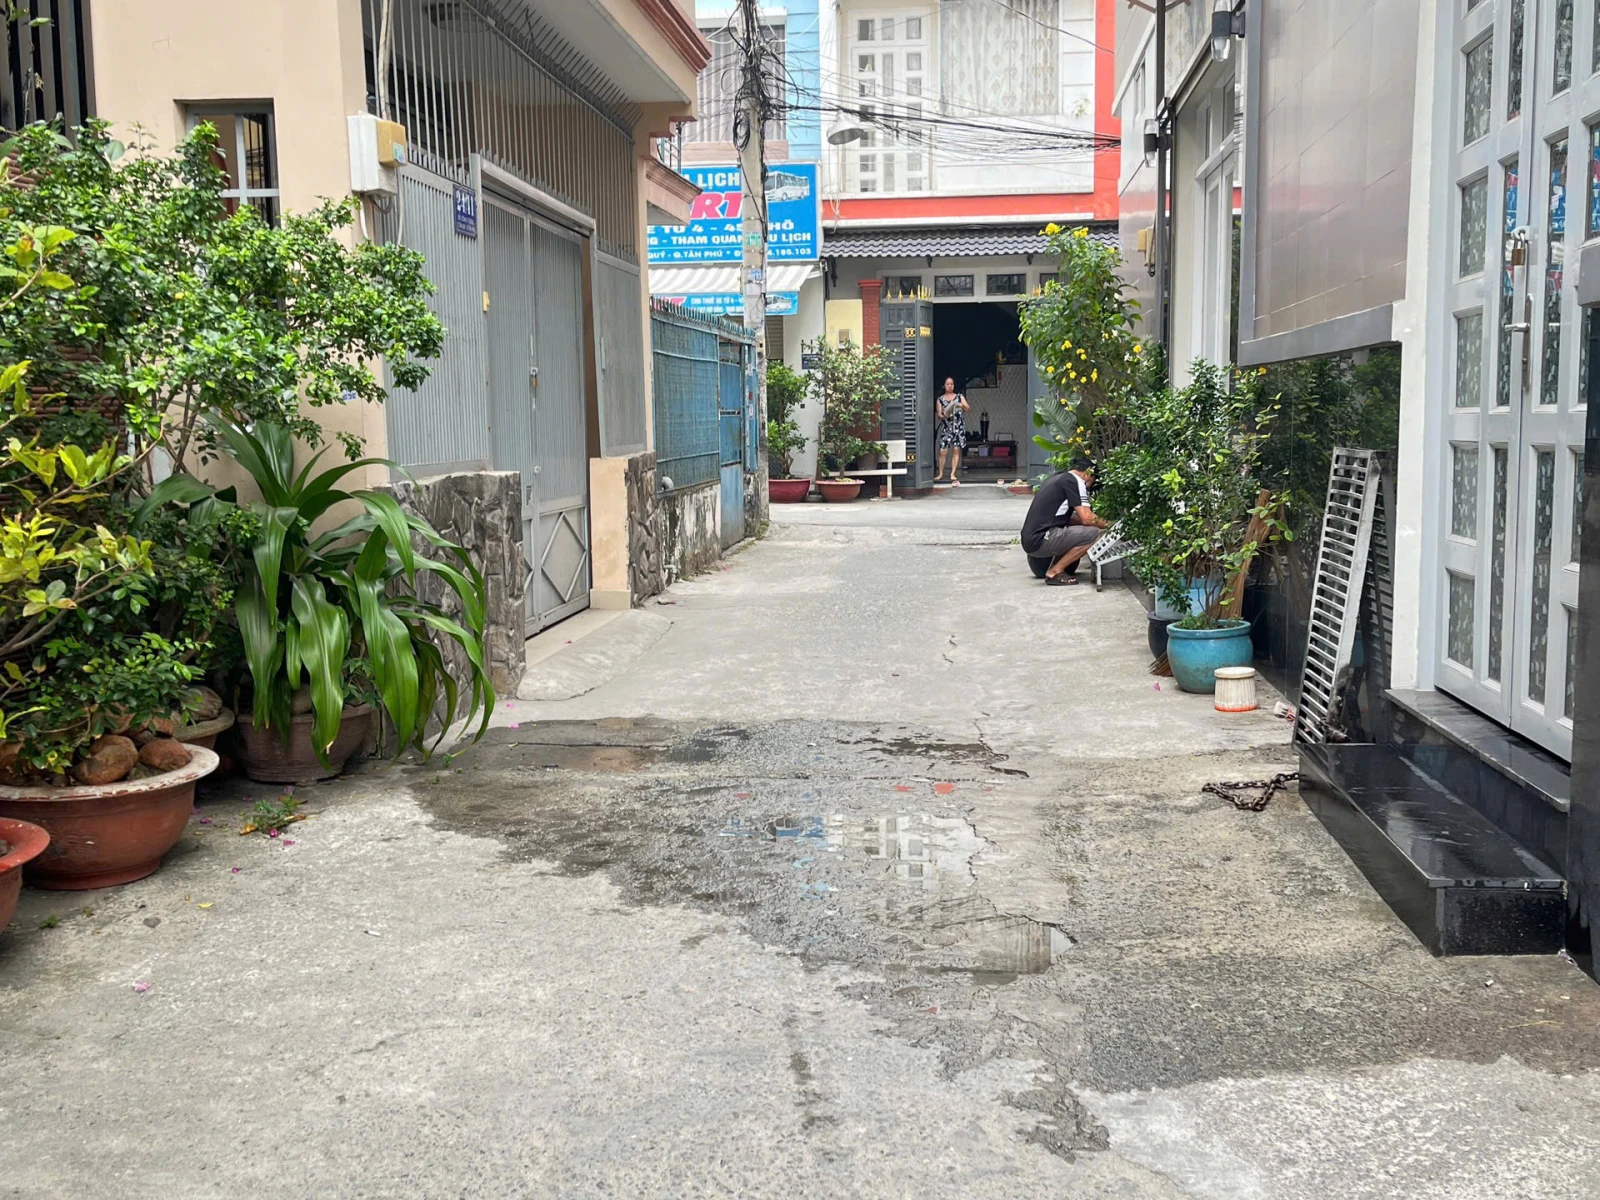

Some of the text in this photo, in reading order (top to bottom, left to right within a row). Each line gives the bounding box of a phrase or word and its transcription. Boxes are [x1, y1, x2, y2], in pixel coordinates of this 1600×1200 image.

[697, 172, 741, 190] LỊCH
[692, 223, 704, 232] 4
[768, 218, 794, 231] HỖ
[670, 235, 708, 245] THAM
[782, 232, 811, 244] LỊCH
[704, 248, 723, 258] PHÚ
